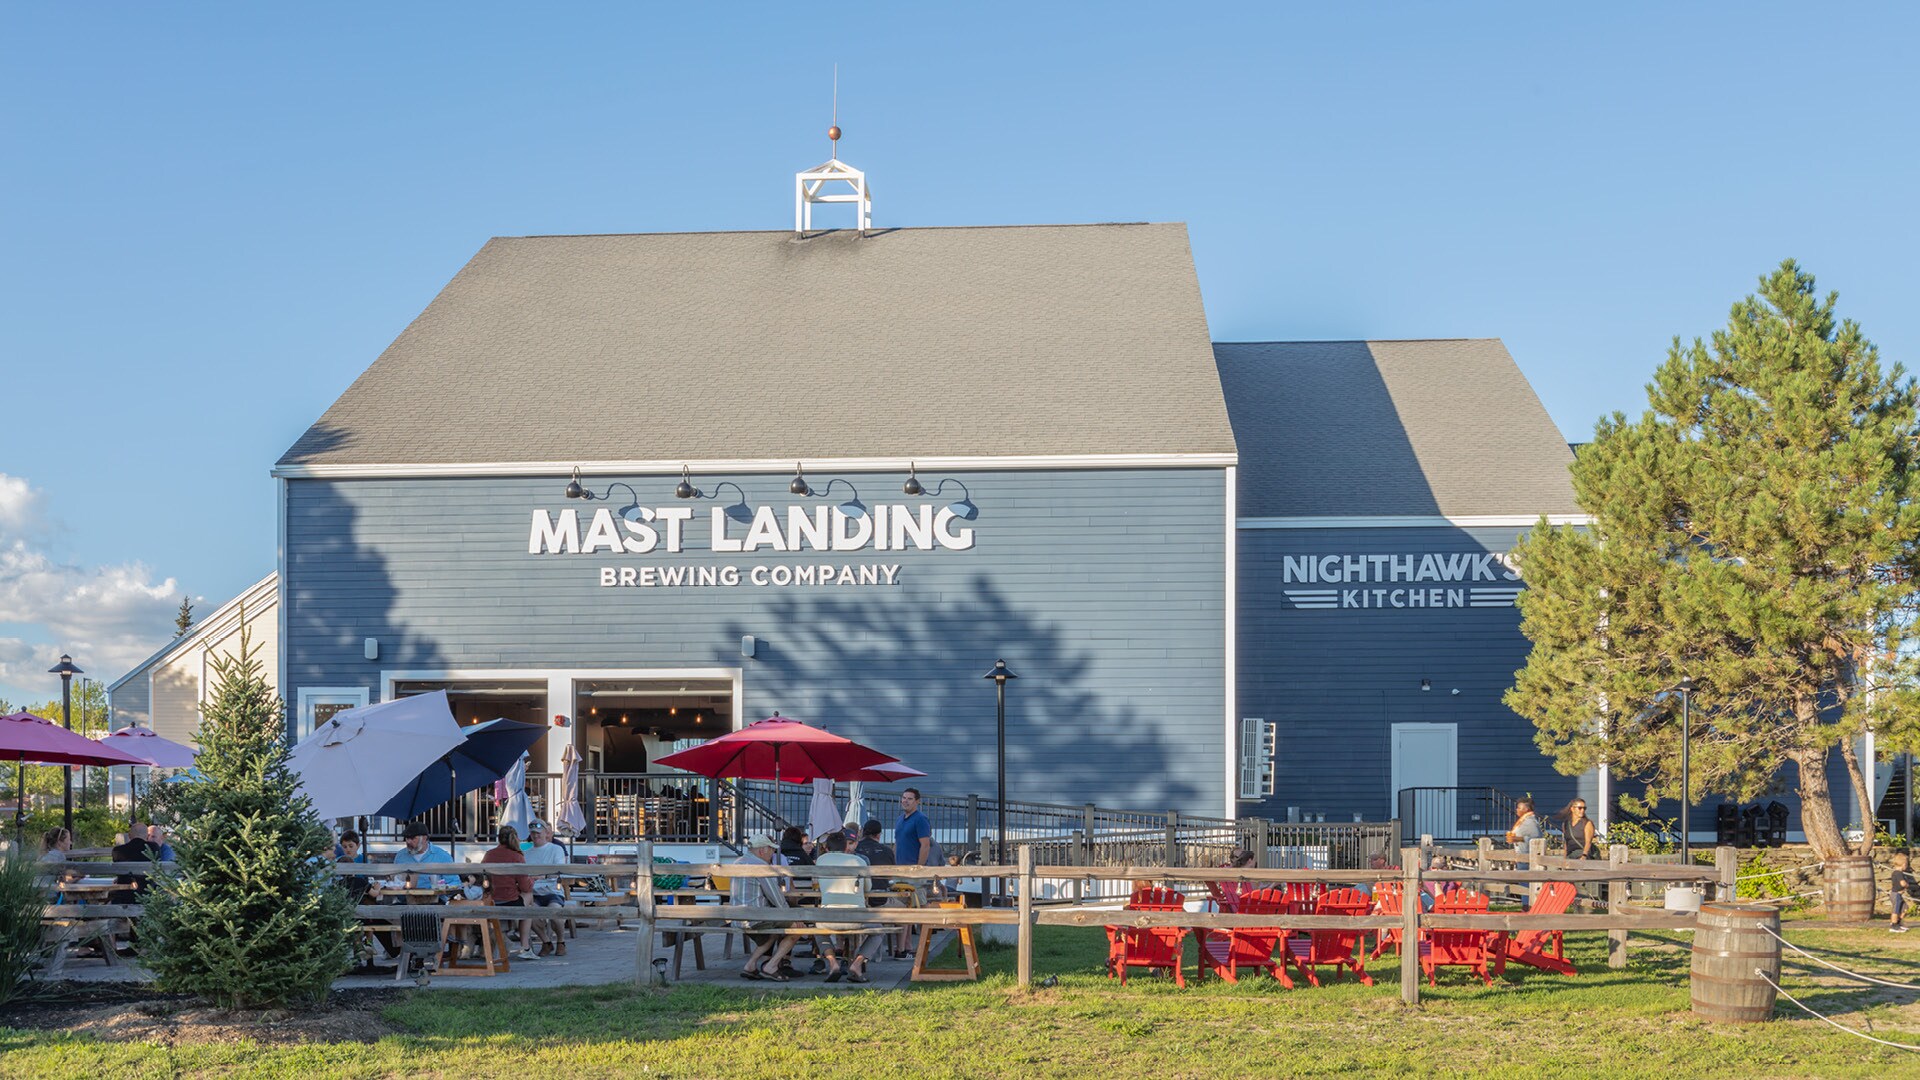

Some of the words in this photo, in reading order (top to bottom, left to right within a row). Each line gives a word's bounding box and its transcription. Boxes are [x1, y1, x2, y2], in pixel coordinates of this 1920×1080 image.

[528, 505, 692, 554] MAST
[711, 504, 974, 552] LANDING
[600, 565, 739, 587] BREWING
[750, 564, 899, 586] COMPANY
[1282, 553, 1523, 583] NIGHTHAWK'S
[1342, 588, 1464, 608] KITCHEN
